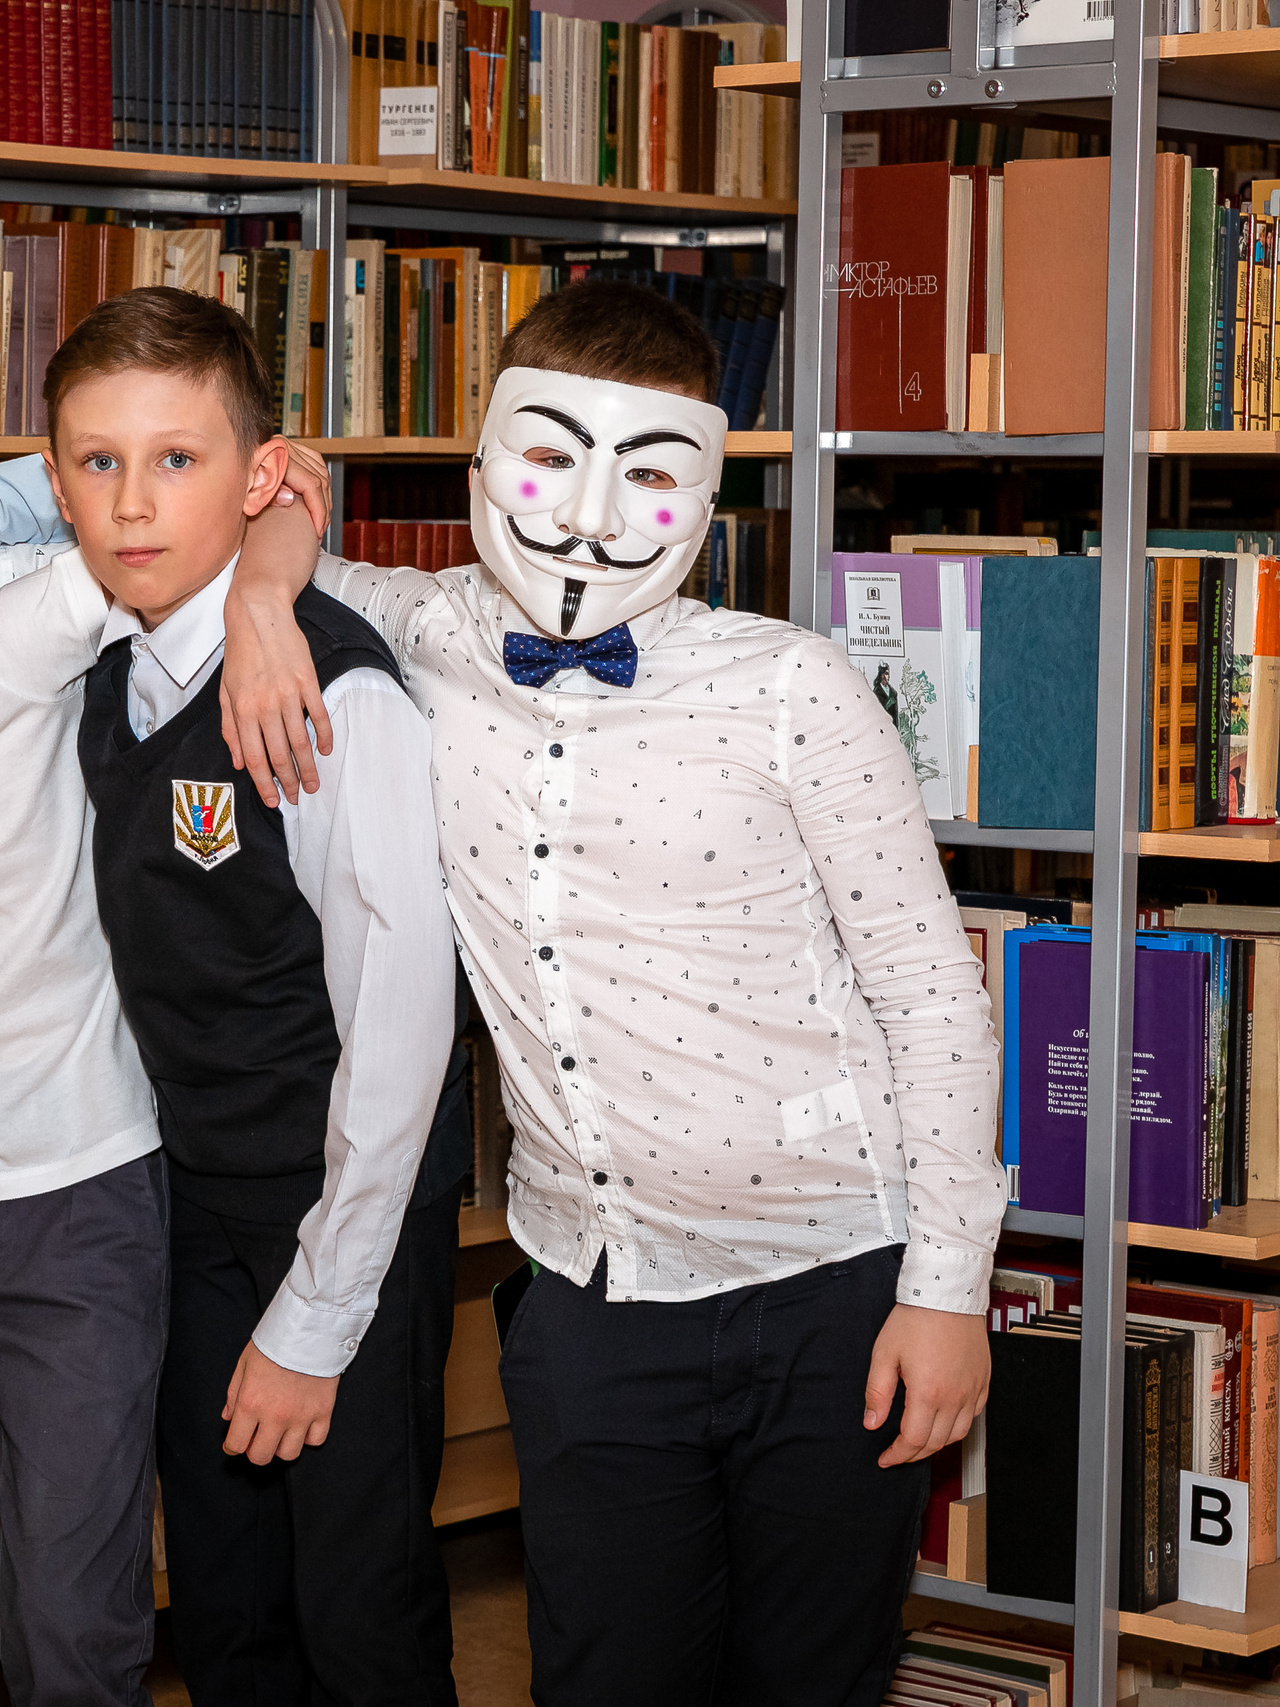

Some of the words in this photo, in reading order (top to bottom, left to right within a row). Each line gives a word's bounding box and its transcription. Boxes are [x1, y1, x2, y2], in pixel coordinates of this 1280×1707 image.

[381, 104, 435, 114] ТУРГЕНЕВ
[848, 275, 938, 299] АСТАФЬЕВ
[1253, 304, 1263, 321] Танго
[904, 371, 922, 402] 4
[873, 613, 891, 622] Бунин
[1212, 579, 1221, 638] ПЛЕЯДЫ
[859, 624, 891, 635] ЧИСТЫЙ
[1221, 586, 1234, 675] Судьбы
[849, 637, 903, 649] ПОНЕДЕЛЬНИК
[1210, 644, 1219, 745] ТЮТЧЕВСКОЙ
[1219, 678, 1231, 734] След
[1210, 749, 1218, 800] ПОЭТЫ
[1072, 1028, 1085, 1039] Об
[1048, 1043, 1081, 1053] Искусство
[1048, 1051, 1078, 1061] Наследие
[1133, 1052, 1155, 1060] полно,
[1245, 1012, 1253, 1090] ВЫСОЦКИЙ
[1048, 1060, 1069, 1068] Найти
[1069, 1061, 1084, 1069] себя
[1062, 1070, 1085, 1078] влечёт,
[1064, 1083, 1079, 1091] есть
[1138, 1090, 1163, 1099] дерзай.
[1048, 1090, 1063, 1098] Будь
[1135, 1099, 1158, 1107] рядом.
[1047, 1106, 1079, 1115] Одаривай
[1141, 1115, 1174, 1125] взглядом.
[1207, 1102, 1216, 1158] Журкина
[1243, 1093, 1252, 1170] ВЛАДИМИР
[1206, 1160, 1215, 1202] Галина
[1224, 1379, 1232, 1423] КОНСУЛ
[1242, 1413, 1250, 1461] ЧЕРНЫЙ
[1222, 1427, 1231, 1475] ЧЕРНЫЙ
[1191, 1484, 1234, 1547] В
[1148, 1549, 1155, 1564] 1
[1164, 1542, 1171, 1556] 2
